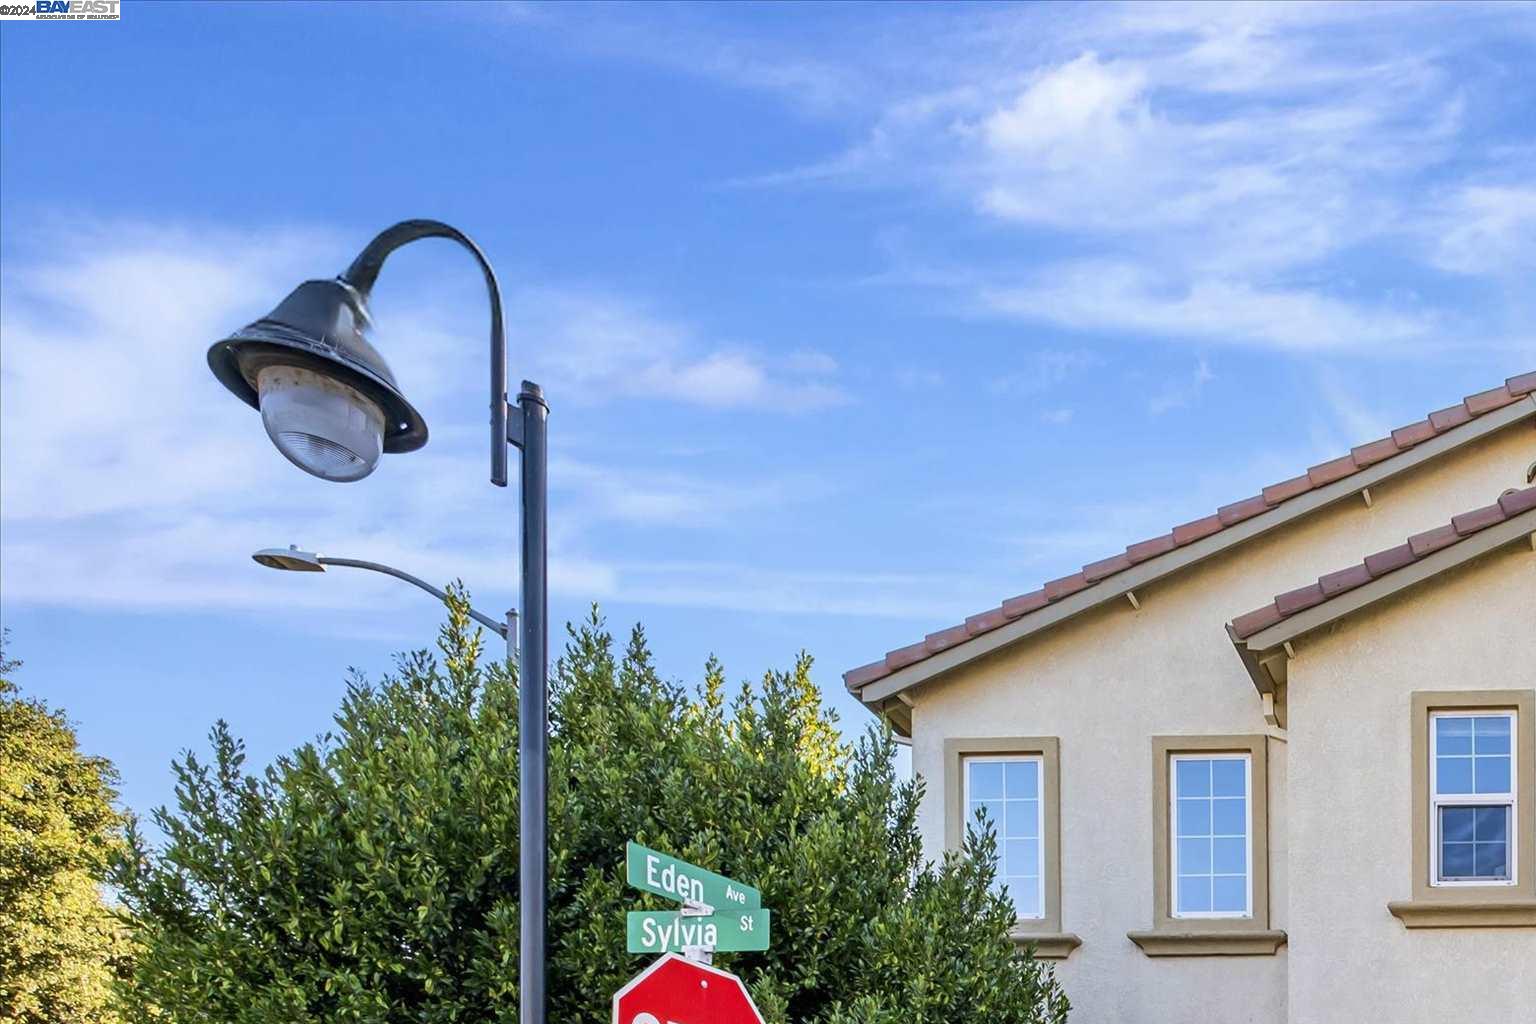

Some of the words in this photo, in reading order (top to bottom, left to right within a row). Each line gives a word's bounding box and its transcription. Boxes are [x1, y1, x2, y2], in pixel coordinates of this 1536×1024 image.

[646, 855, 704, 904] Eden
[726, 884, 746, 905] Ave
[641, 916, 718, 952] Sylvia
[740, 914, 754, 932] St
